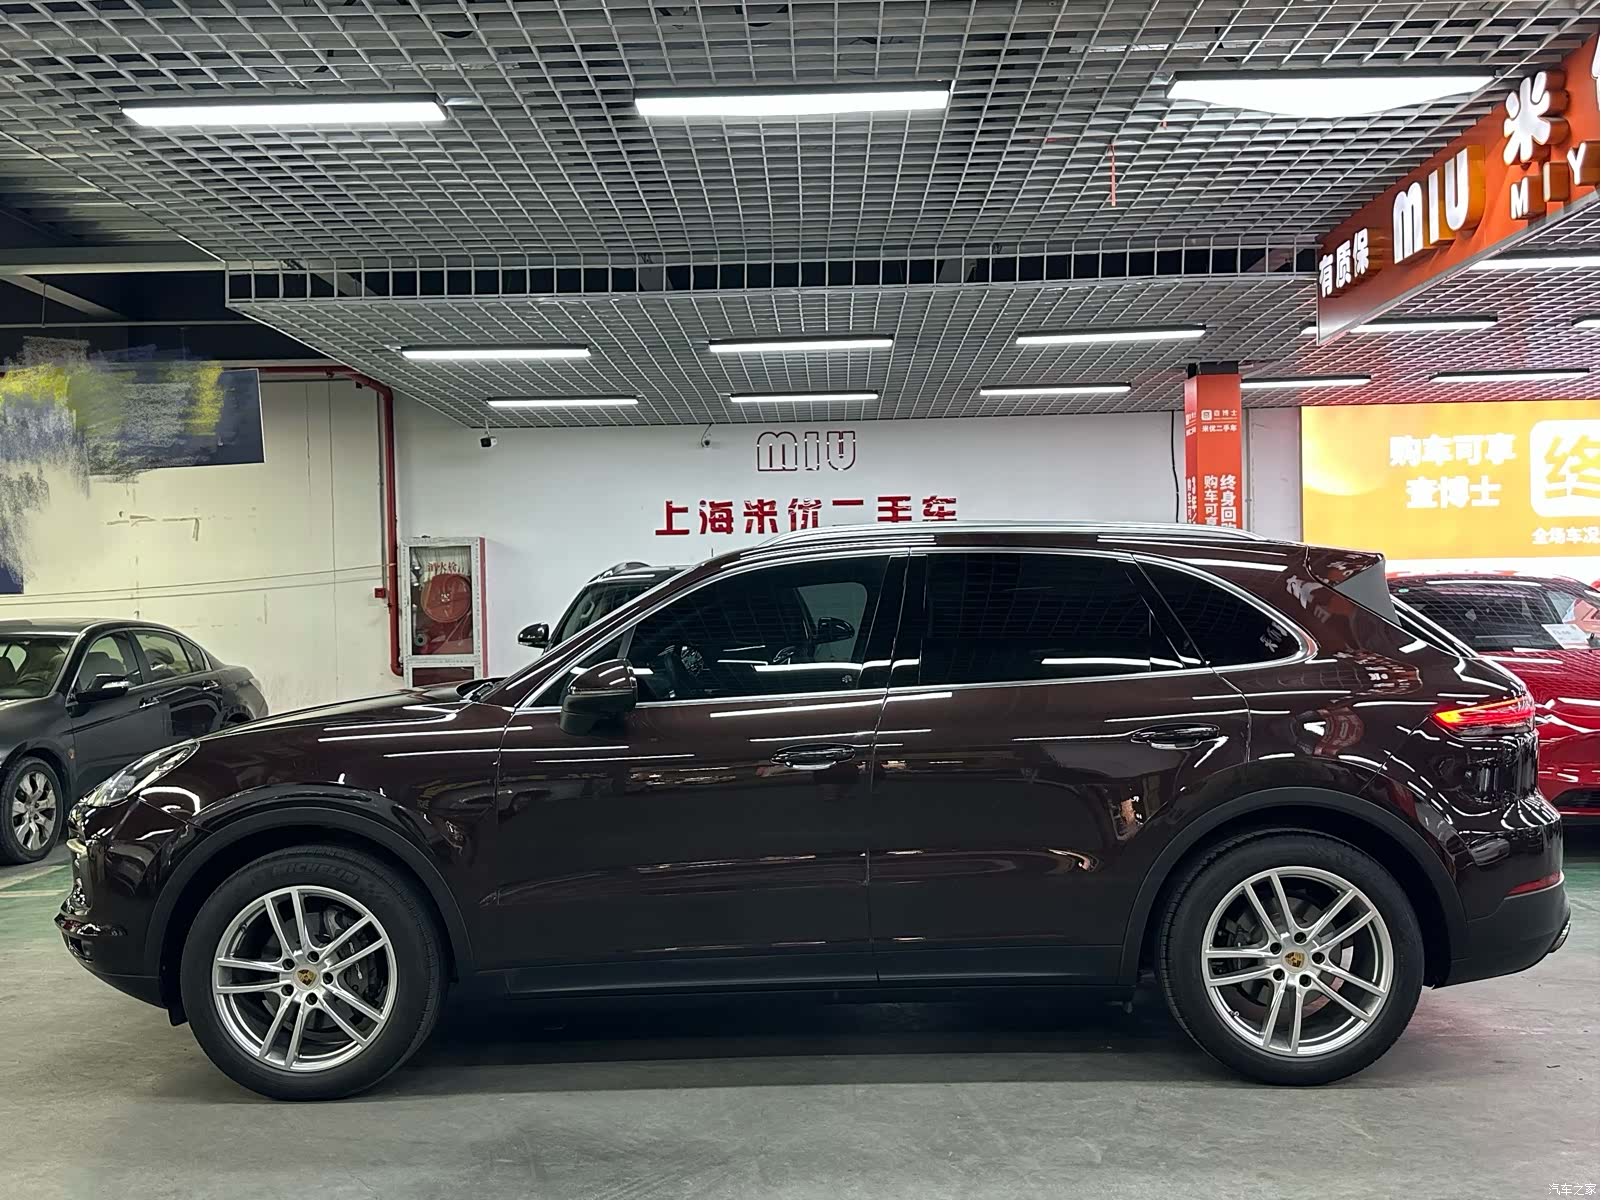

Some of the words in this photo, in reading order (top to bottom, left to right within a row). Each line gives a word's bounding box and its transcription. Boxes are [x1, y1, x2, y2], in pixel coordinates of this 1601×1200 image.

[1510, 142, 1586, 219] MIY
[1393, 147, 1469, 264] MIU
[1319, 228, 1369, 298] 有质保
[1202, 424, 1237, 432] 米优二手车
[757, 431, 855, 471] MIU
[1389, 432, 1517, 467] 购车可享
[1406, 475, 1501, 508] 查博士
